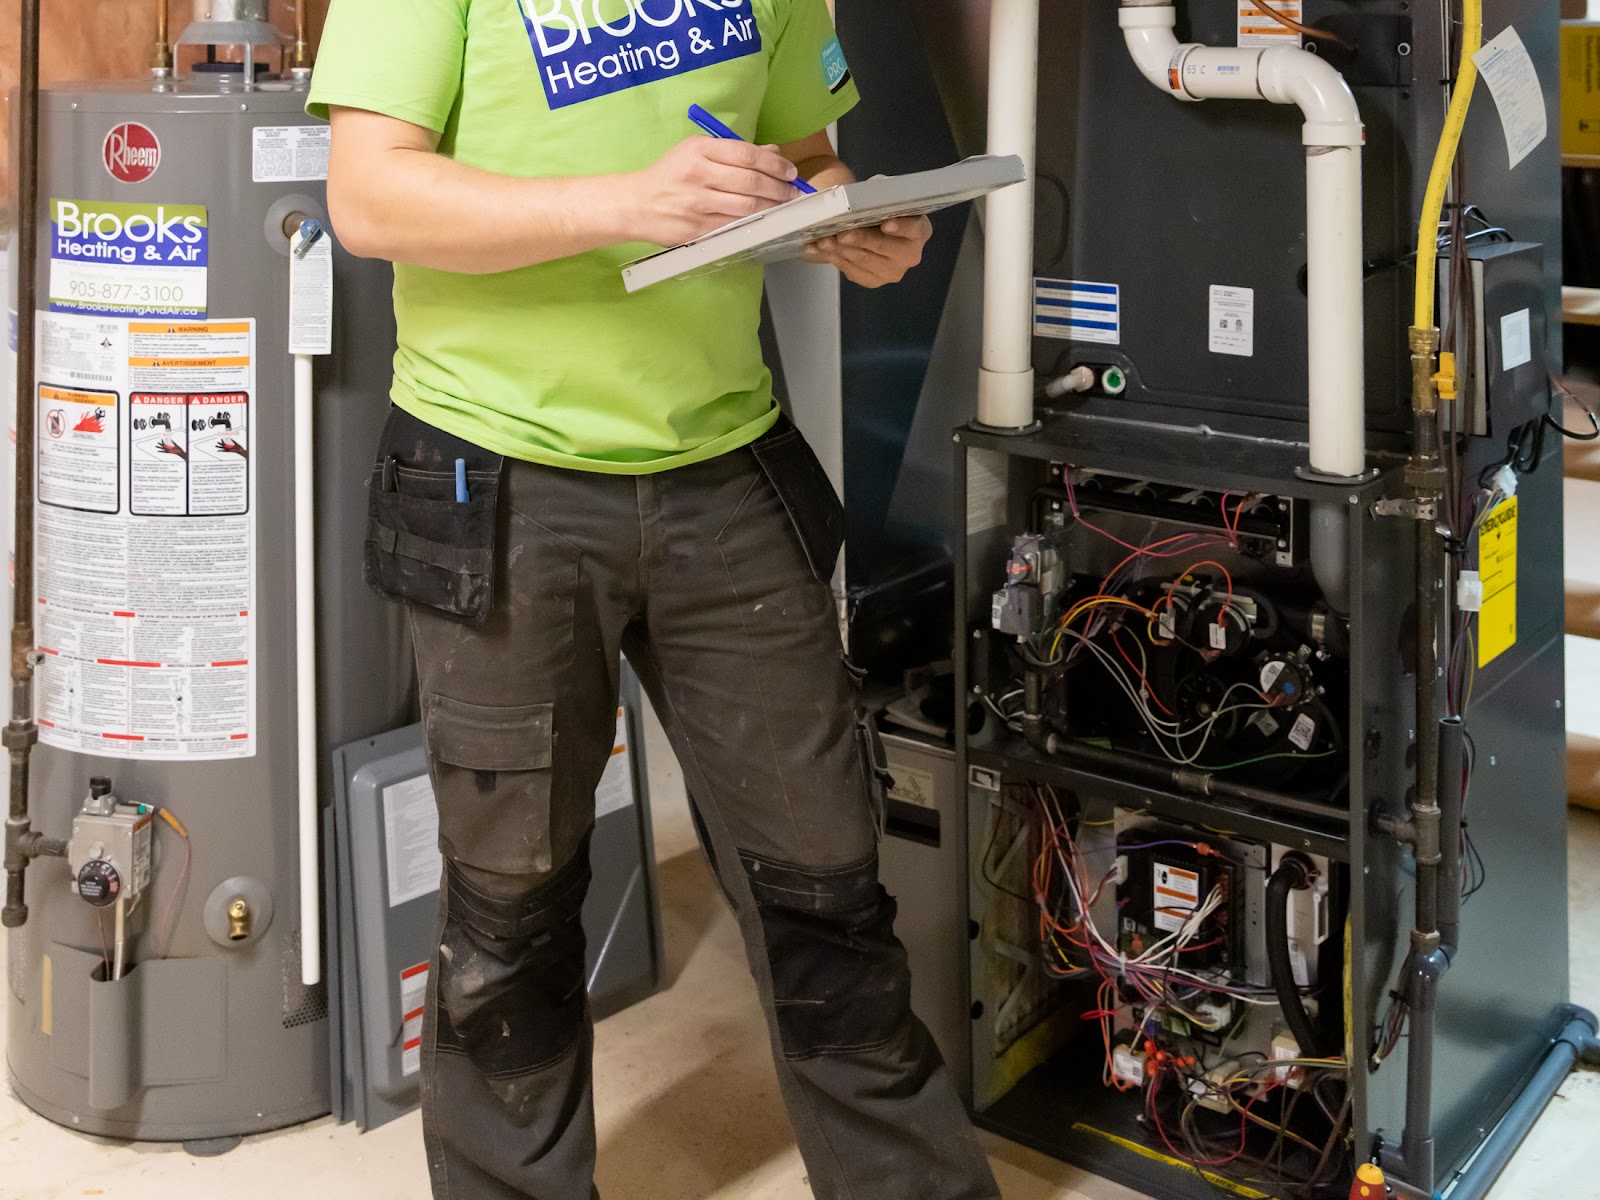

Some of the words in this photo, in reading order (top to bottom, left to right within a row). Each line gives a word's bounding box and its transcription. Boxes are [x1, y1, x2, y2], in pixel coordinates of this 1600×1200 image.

[546, 39, 680, 94] Heating
[687, 26, 715, 55] &
[722, 13, 753, 46] Air
[109, 124, 157, 174] Rheem
[56, 201, 202, 243] Brooks
[57, 238, 137, 263] Heating
[143, 245, 162, 261] &
[167, 245, 202, 261] Air
[69, 280, 184, 302] 905-877-3100
[143, 396, 184, 404] DANGER
[202, 395, 245, 404] DANGER
